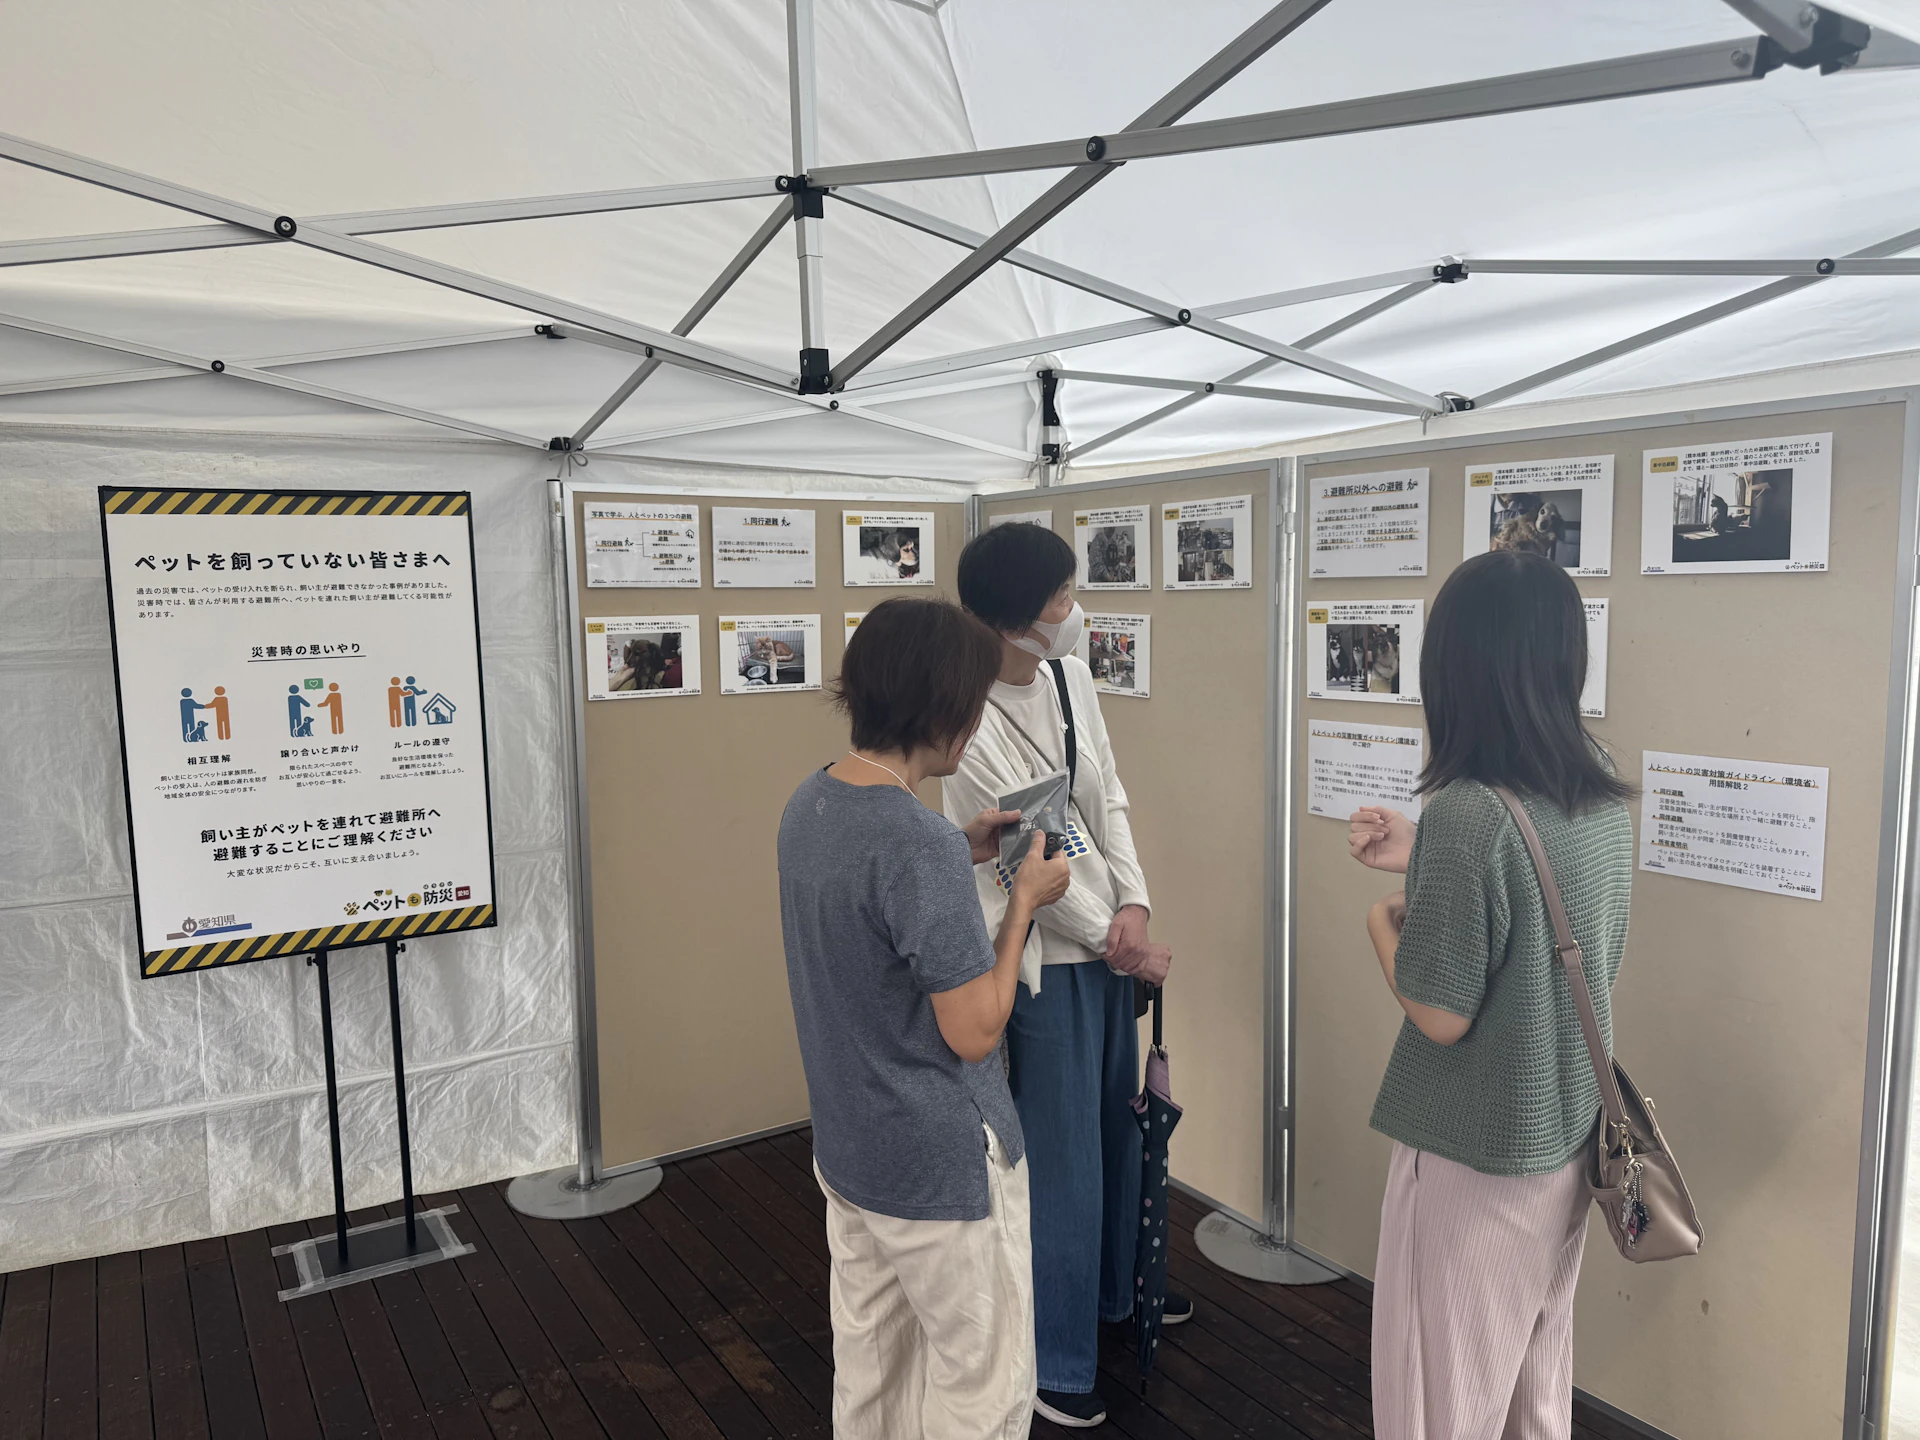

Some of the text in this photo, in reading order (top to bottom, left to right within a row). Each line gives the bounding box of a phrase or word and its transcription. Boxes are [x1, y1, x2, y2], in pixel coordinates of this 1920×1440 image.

[135, 551, 451, 572] ペットを飼っていない皆さまへ
[136, 583, 448, 595] 過去の災害では、ペットの受け入れを断られ、飼い主が避難できなかった事例がありました。
[137, 592, 452, 607] 災害時では、皆さんが利用する避難所へ、ペットを連れた飼い主が避難してくる可能性が
[251, 643, 360, 658] 災害時の思いやり
[394, 737, 450, 749] ルールの遵守
[280, 744, 360, 758] 譲り合いと声かけ
[187, 754, 231, 766] 相互理解
[160, 768, 257, 782] 飼い主にとってペットは家族同然。
[1648, 763, 1818, 788] 人とペットの災害対策ガイドライン（環境省）
[164, 786, 257, 800] 地域全体の安全につながります。
[1659, 787, 1684, 797] 同行避難
[200, 807, 441, 843] 飼い主がペットを連れて避難所へ
[1659, 813, 1684, 823] 同伴避難
[213, 826, 433, 862] 避難することにご理解ください
[226, 849, 420, 878] 大変な状況だからこそ、互いに支え合いましょう。
[198, 914, 236, 928] 愛知県
